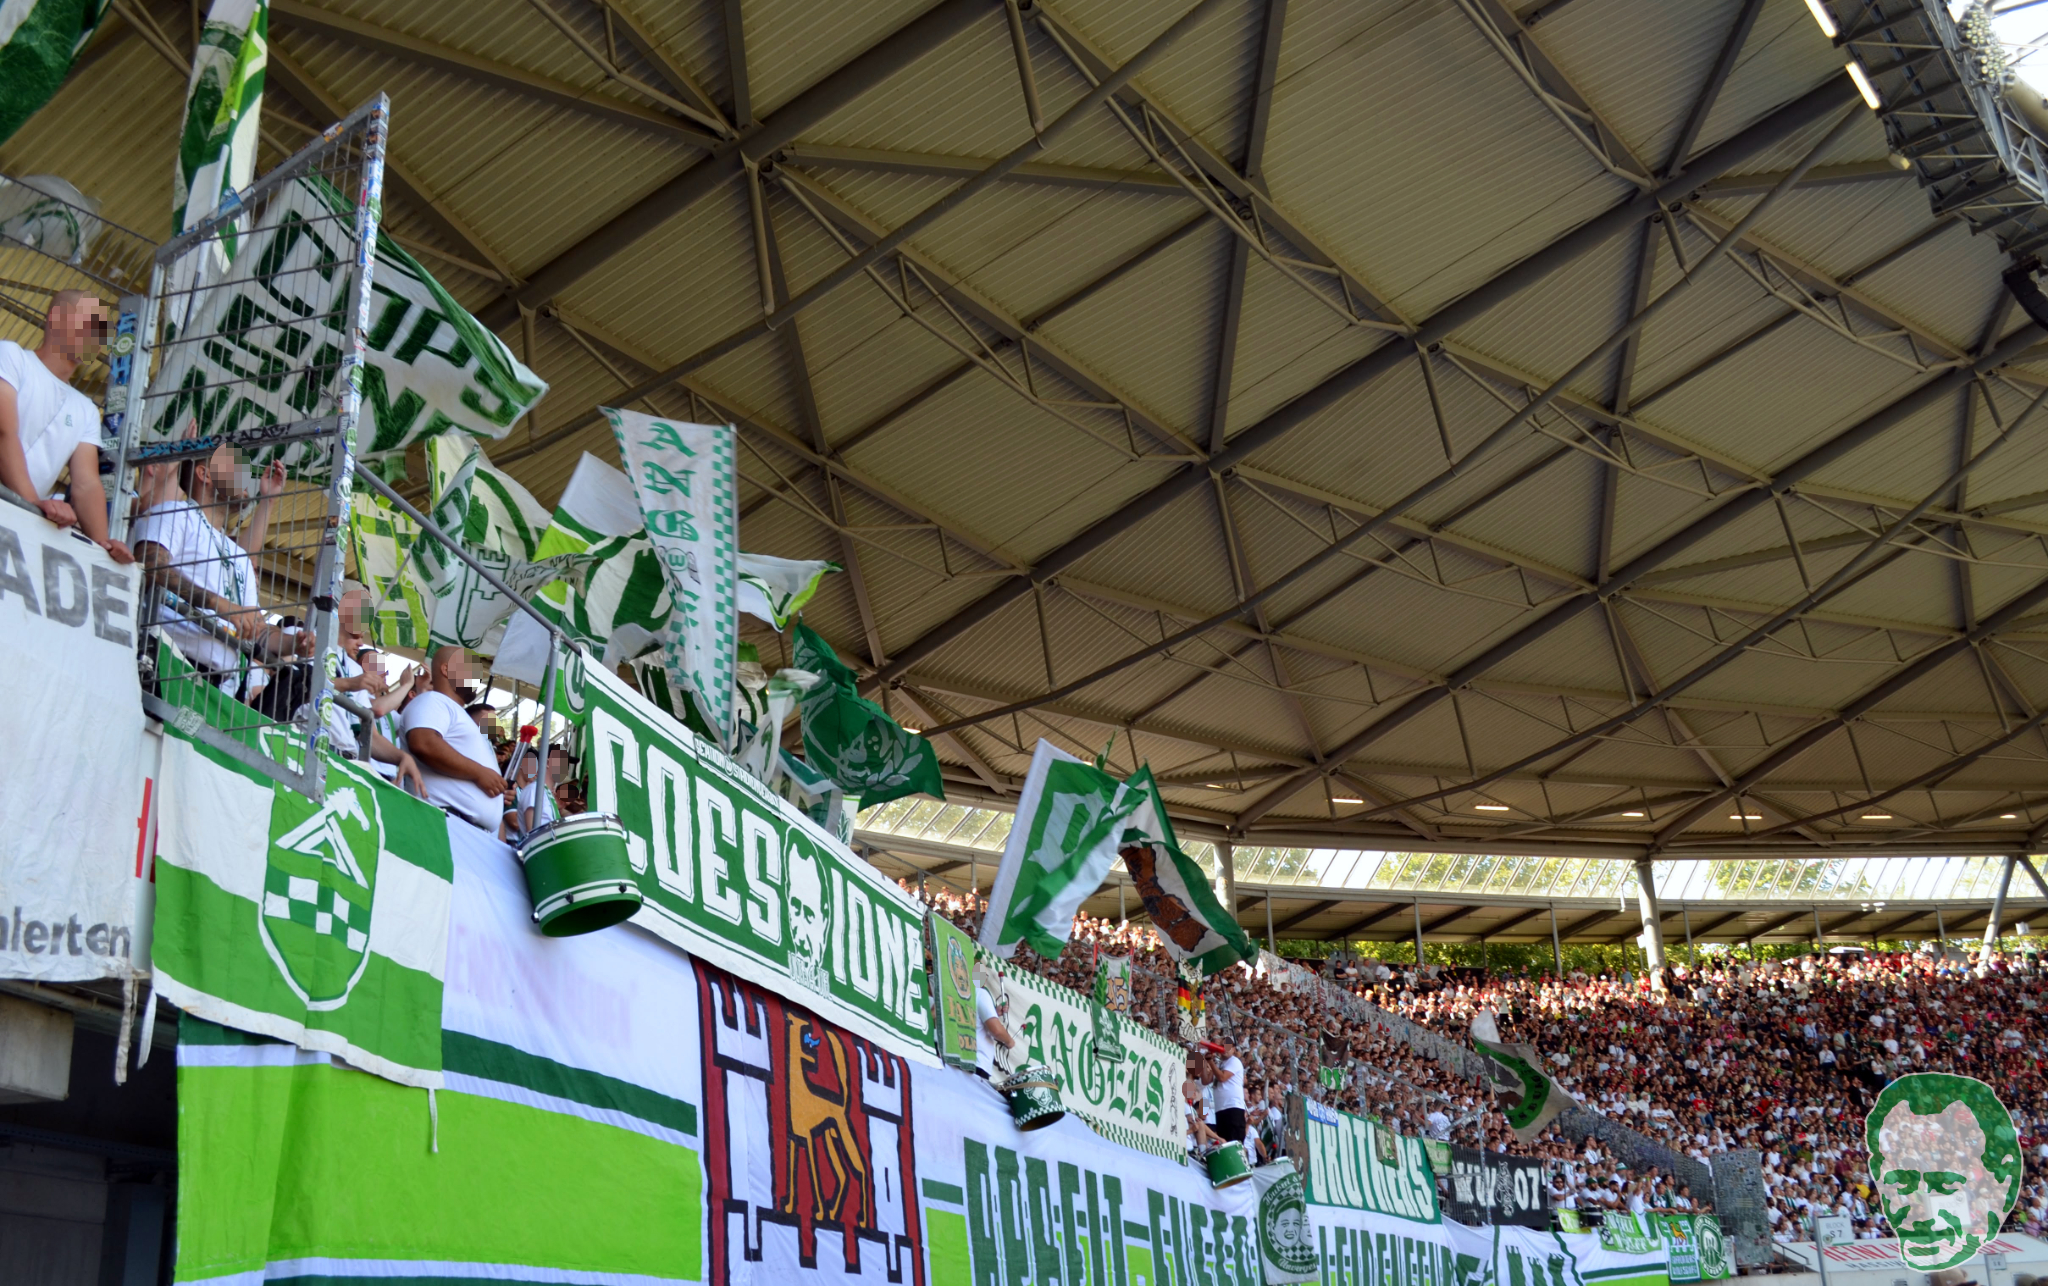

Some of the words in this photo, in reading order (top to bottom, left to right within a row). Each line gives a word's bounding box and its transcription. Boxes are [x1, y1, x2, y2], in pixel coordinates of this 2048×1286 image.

[1014, 1003, 1165, 1128] ANGELS
[1307, 1109, 1436, 1221] BROTHERS
[1514, 1167, 1541, 1211] 07
[1825, 1221, 1845, 1230] BLOCK
